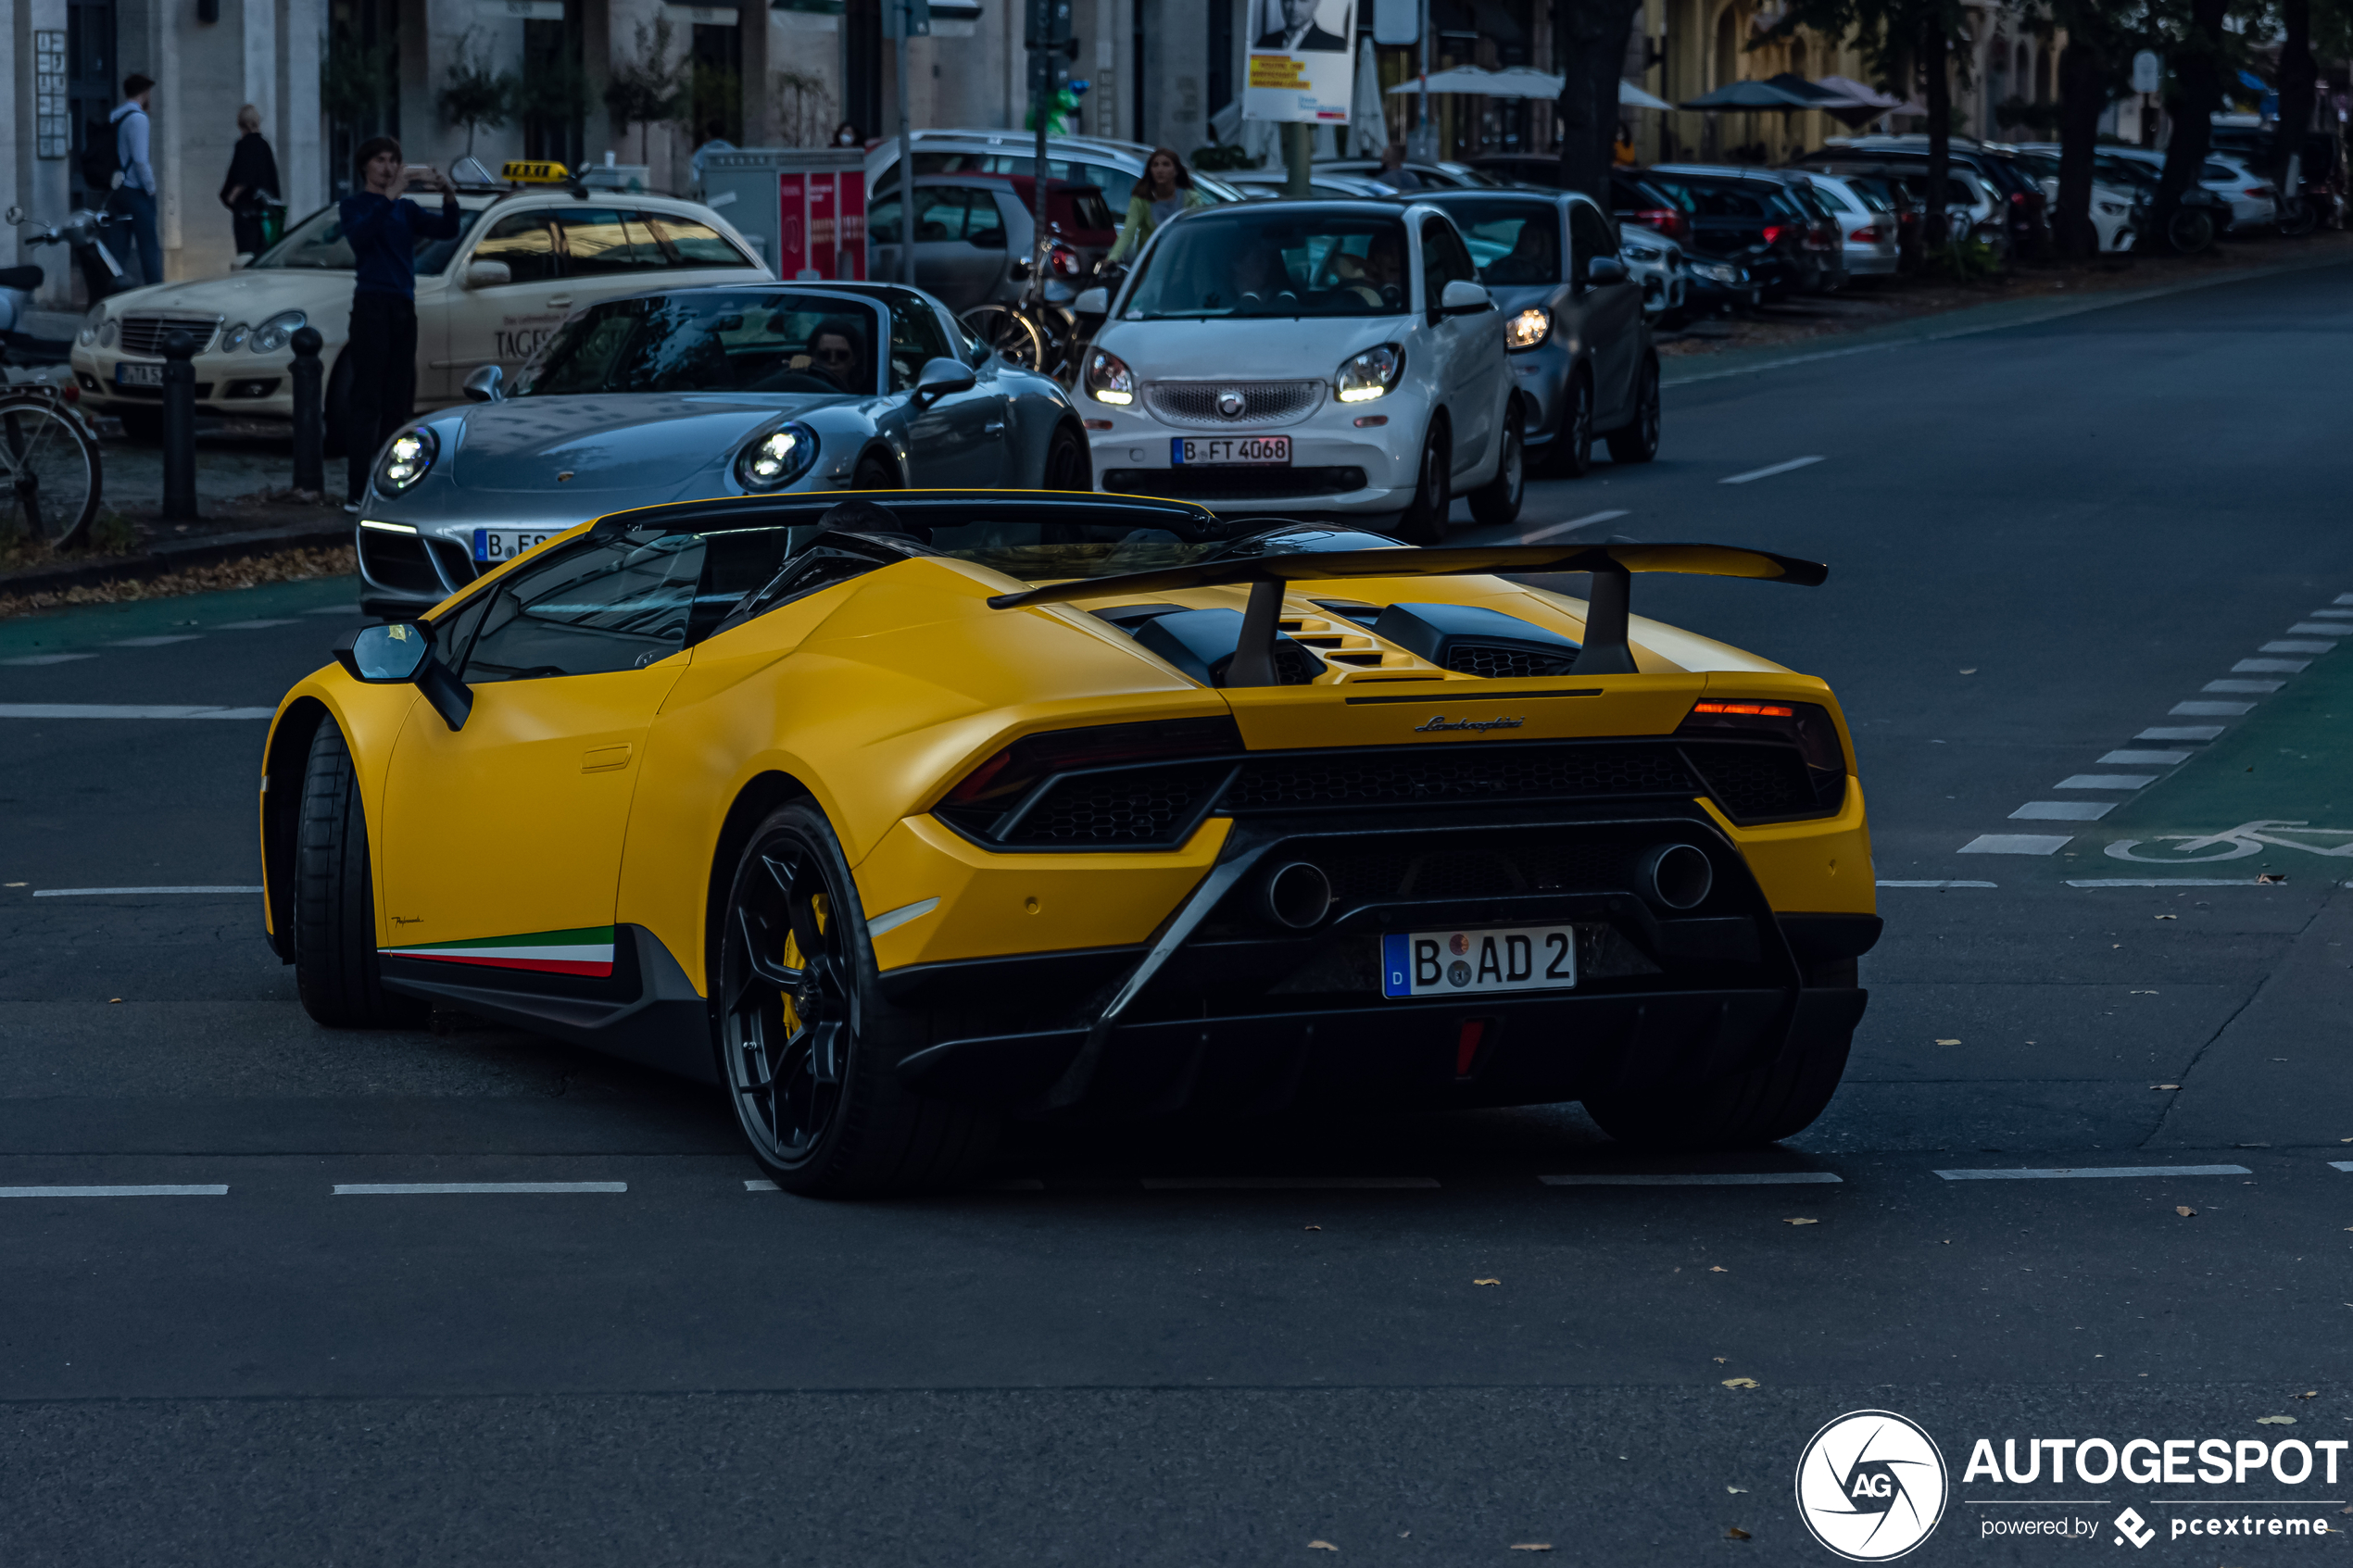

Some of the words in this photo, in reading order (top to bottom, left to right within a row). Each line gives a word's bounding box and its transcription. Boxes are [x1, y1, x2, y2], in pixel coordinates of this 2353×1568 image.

[506, 164, 548, 177] TAXI
[1185, 442, 1196, 460] B
[1209, 441, 1233, 459] FT
[1239, 440, 1286, 459] 4068
[488, 534, 501, 557] B
[1415, 715, 1526, 733] Lamborghini
[1392, 972, 1403, 985] D
[1415, 939, 1442, 987] B
[1477, 935, 1532, 984] AD
[1545, 933, 1570, 980] 2
